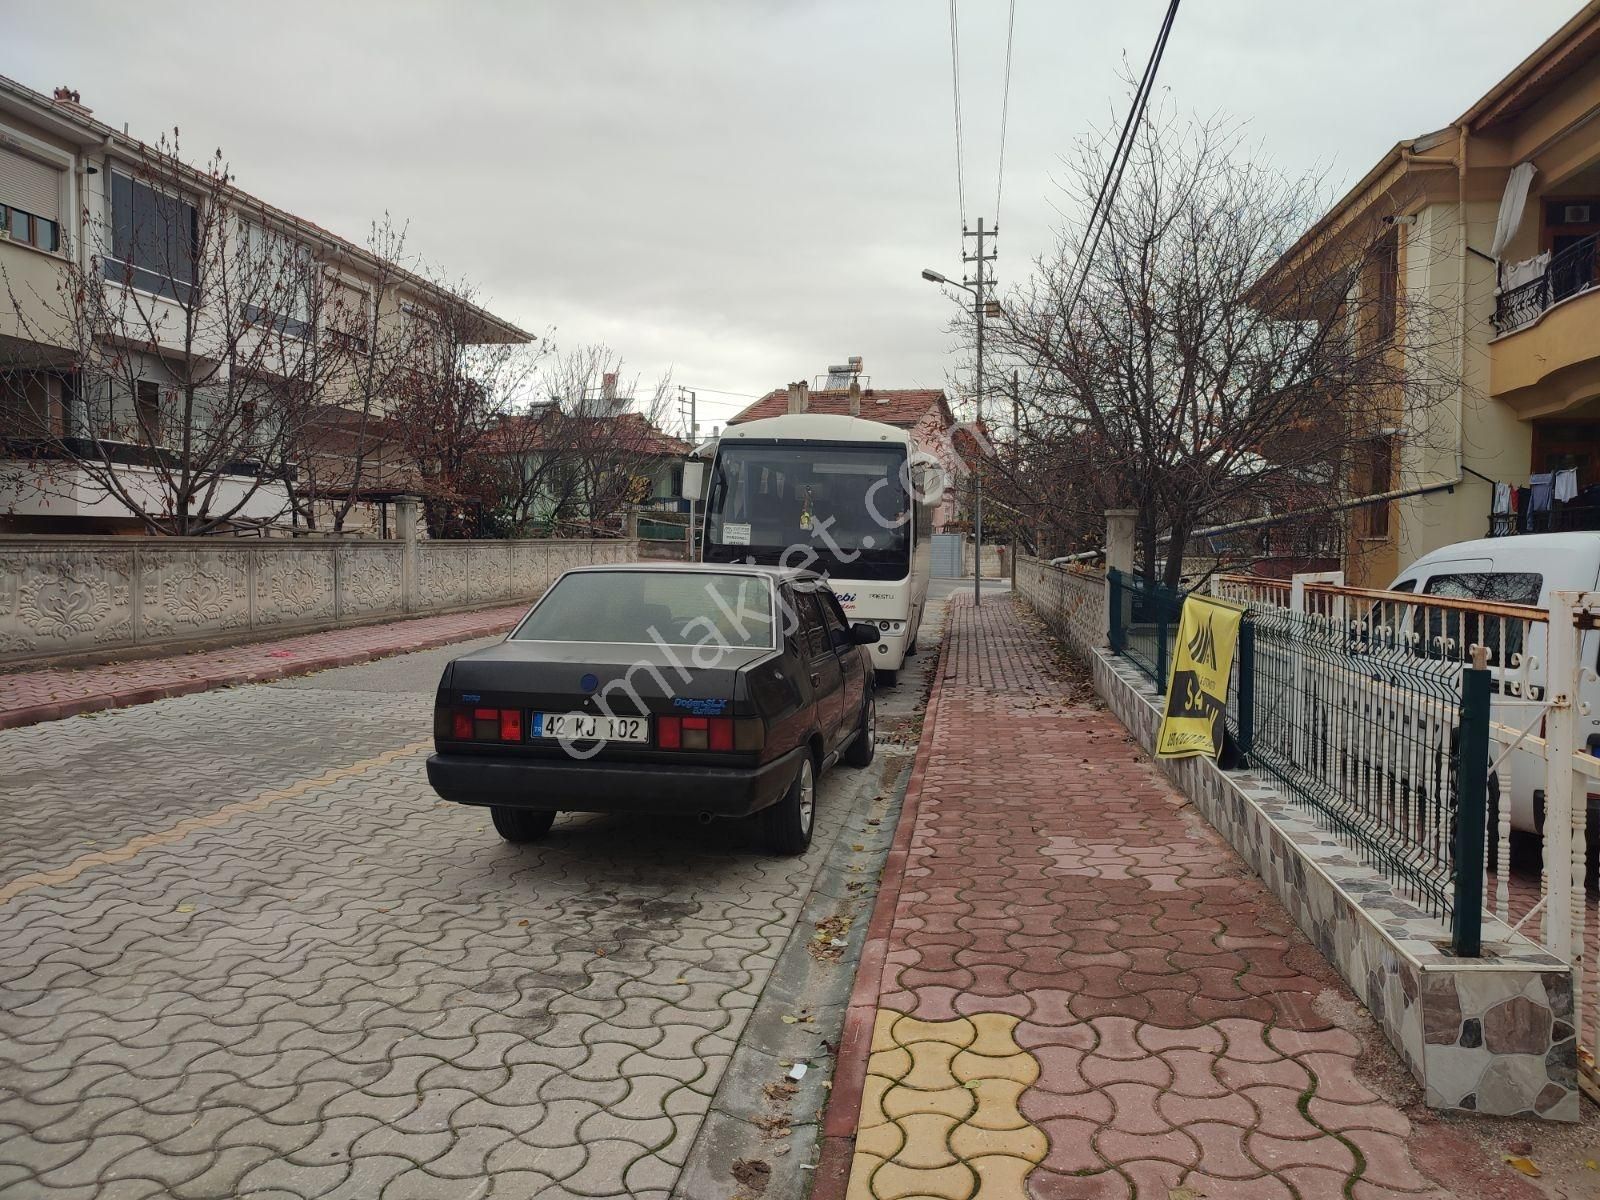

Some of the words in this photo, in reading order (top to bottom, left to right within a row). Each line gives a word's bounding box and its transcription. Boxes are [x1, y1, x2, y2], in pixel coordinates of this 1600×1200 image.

[545, 716, 566, 735] 42
[575, 717, 596, 737] KJ
[608, 719, 639, 739] 102
